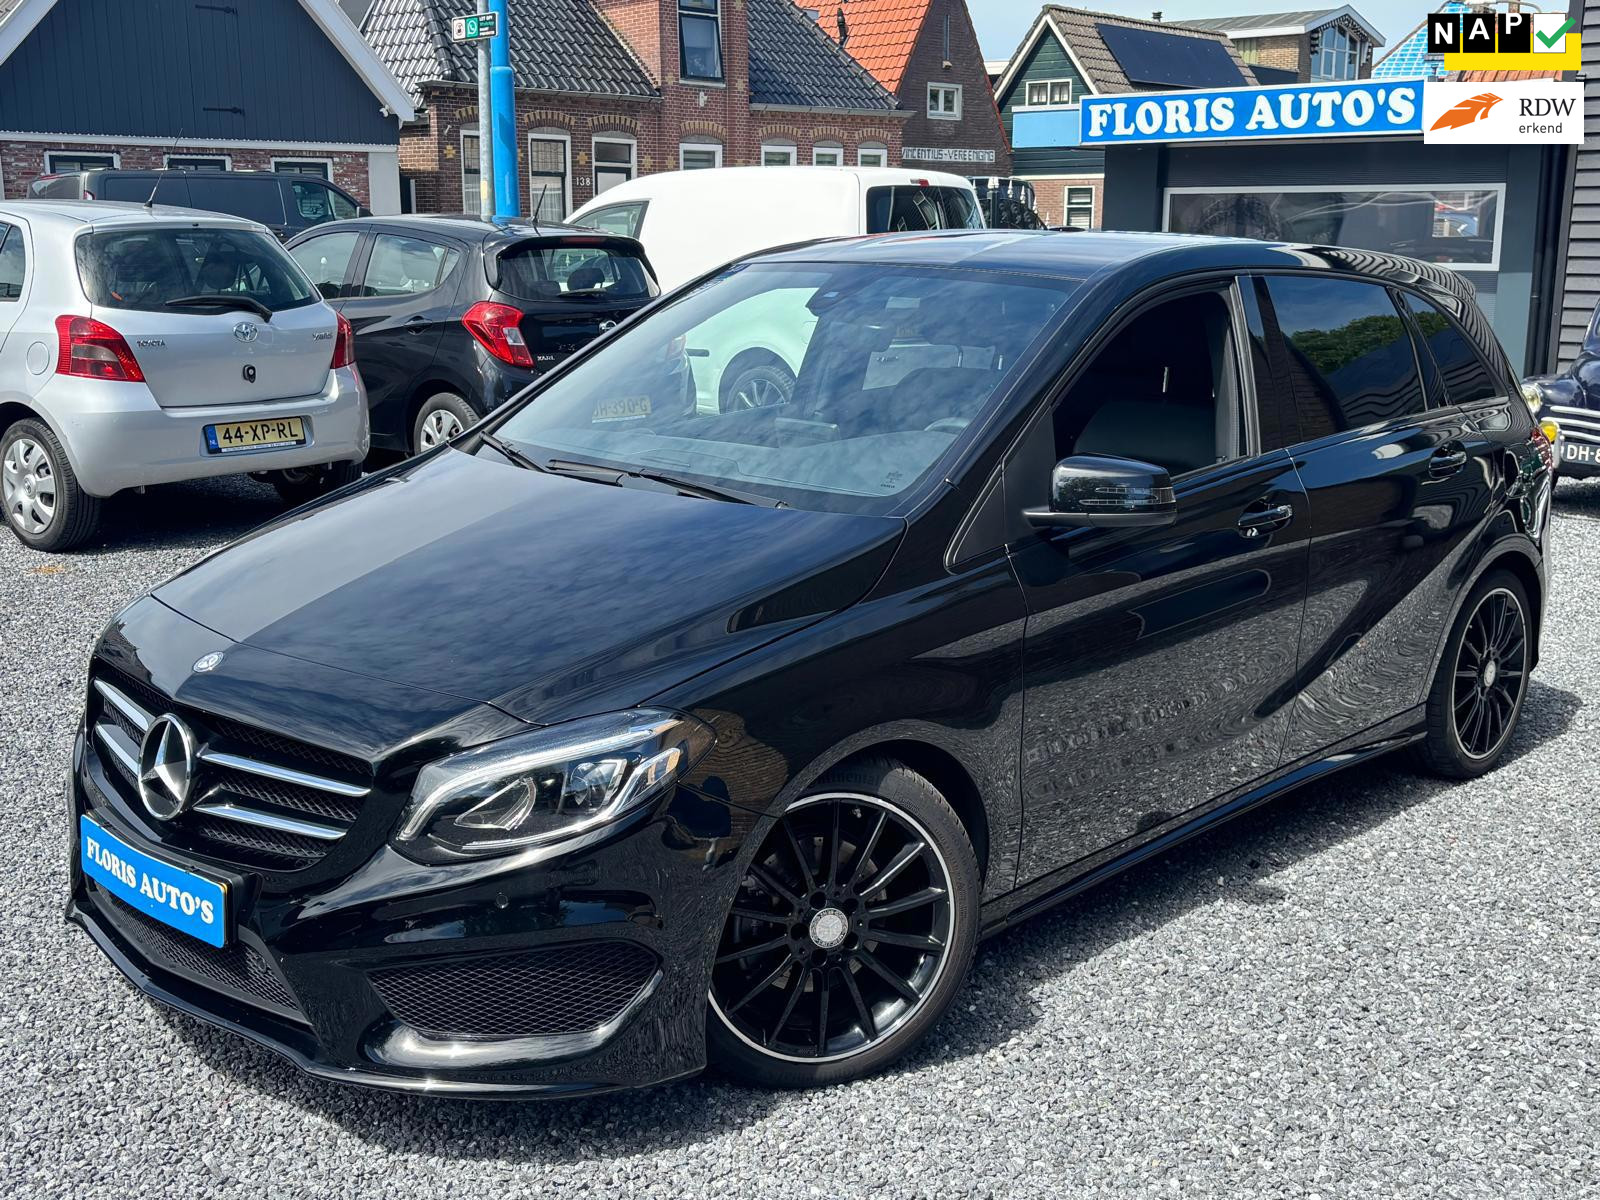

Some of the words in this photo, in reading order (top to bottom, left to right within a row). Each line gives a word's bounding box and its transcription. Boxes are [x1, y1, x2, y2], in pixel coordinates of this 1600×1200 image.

[1088, 97, 1235, 137] FLORIS
[1245, 87, 1416, 130] AUTO'S
[576, 176, 591, 186] 138
[136, 339, 166, 348] TOYOTA
[222, 421, 299, 444] 44-XP-RL
[86, 835, 137, 889] FLORIS
